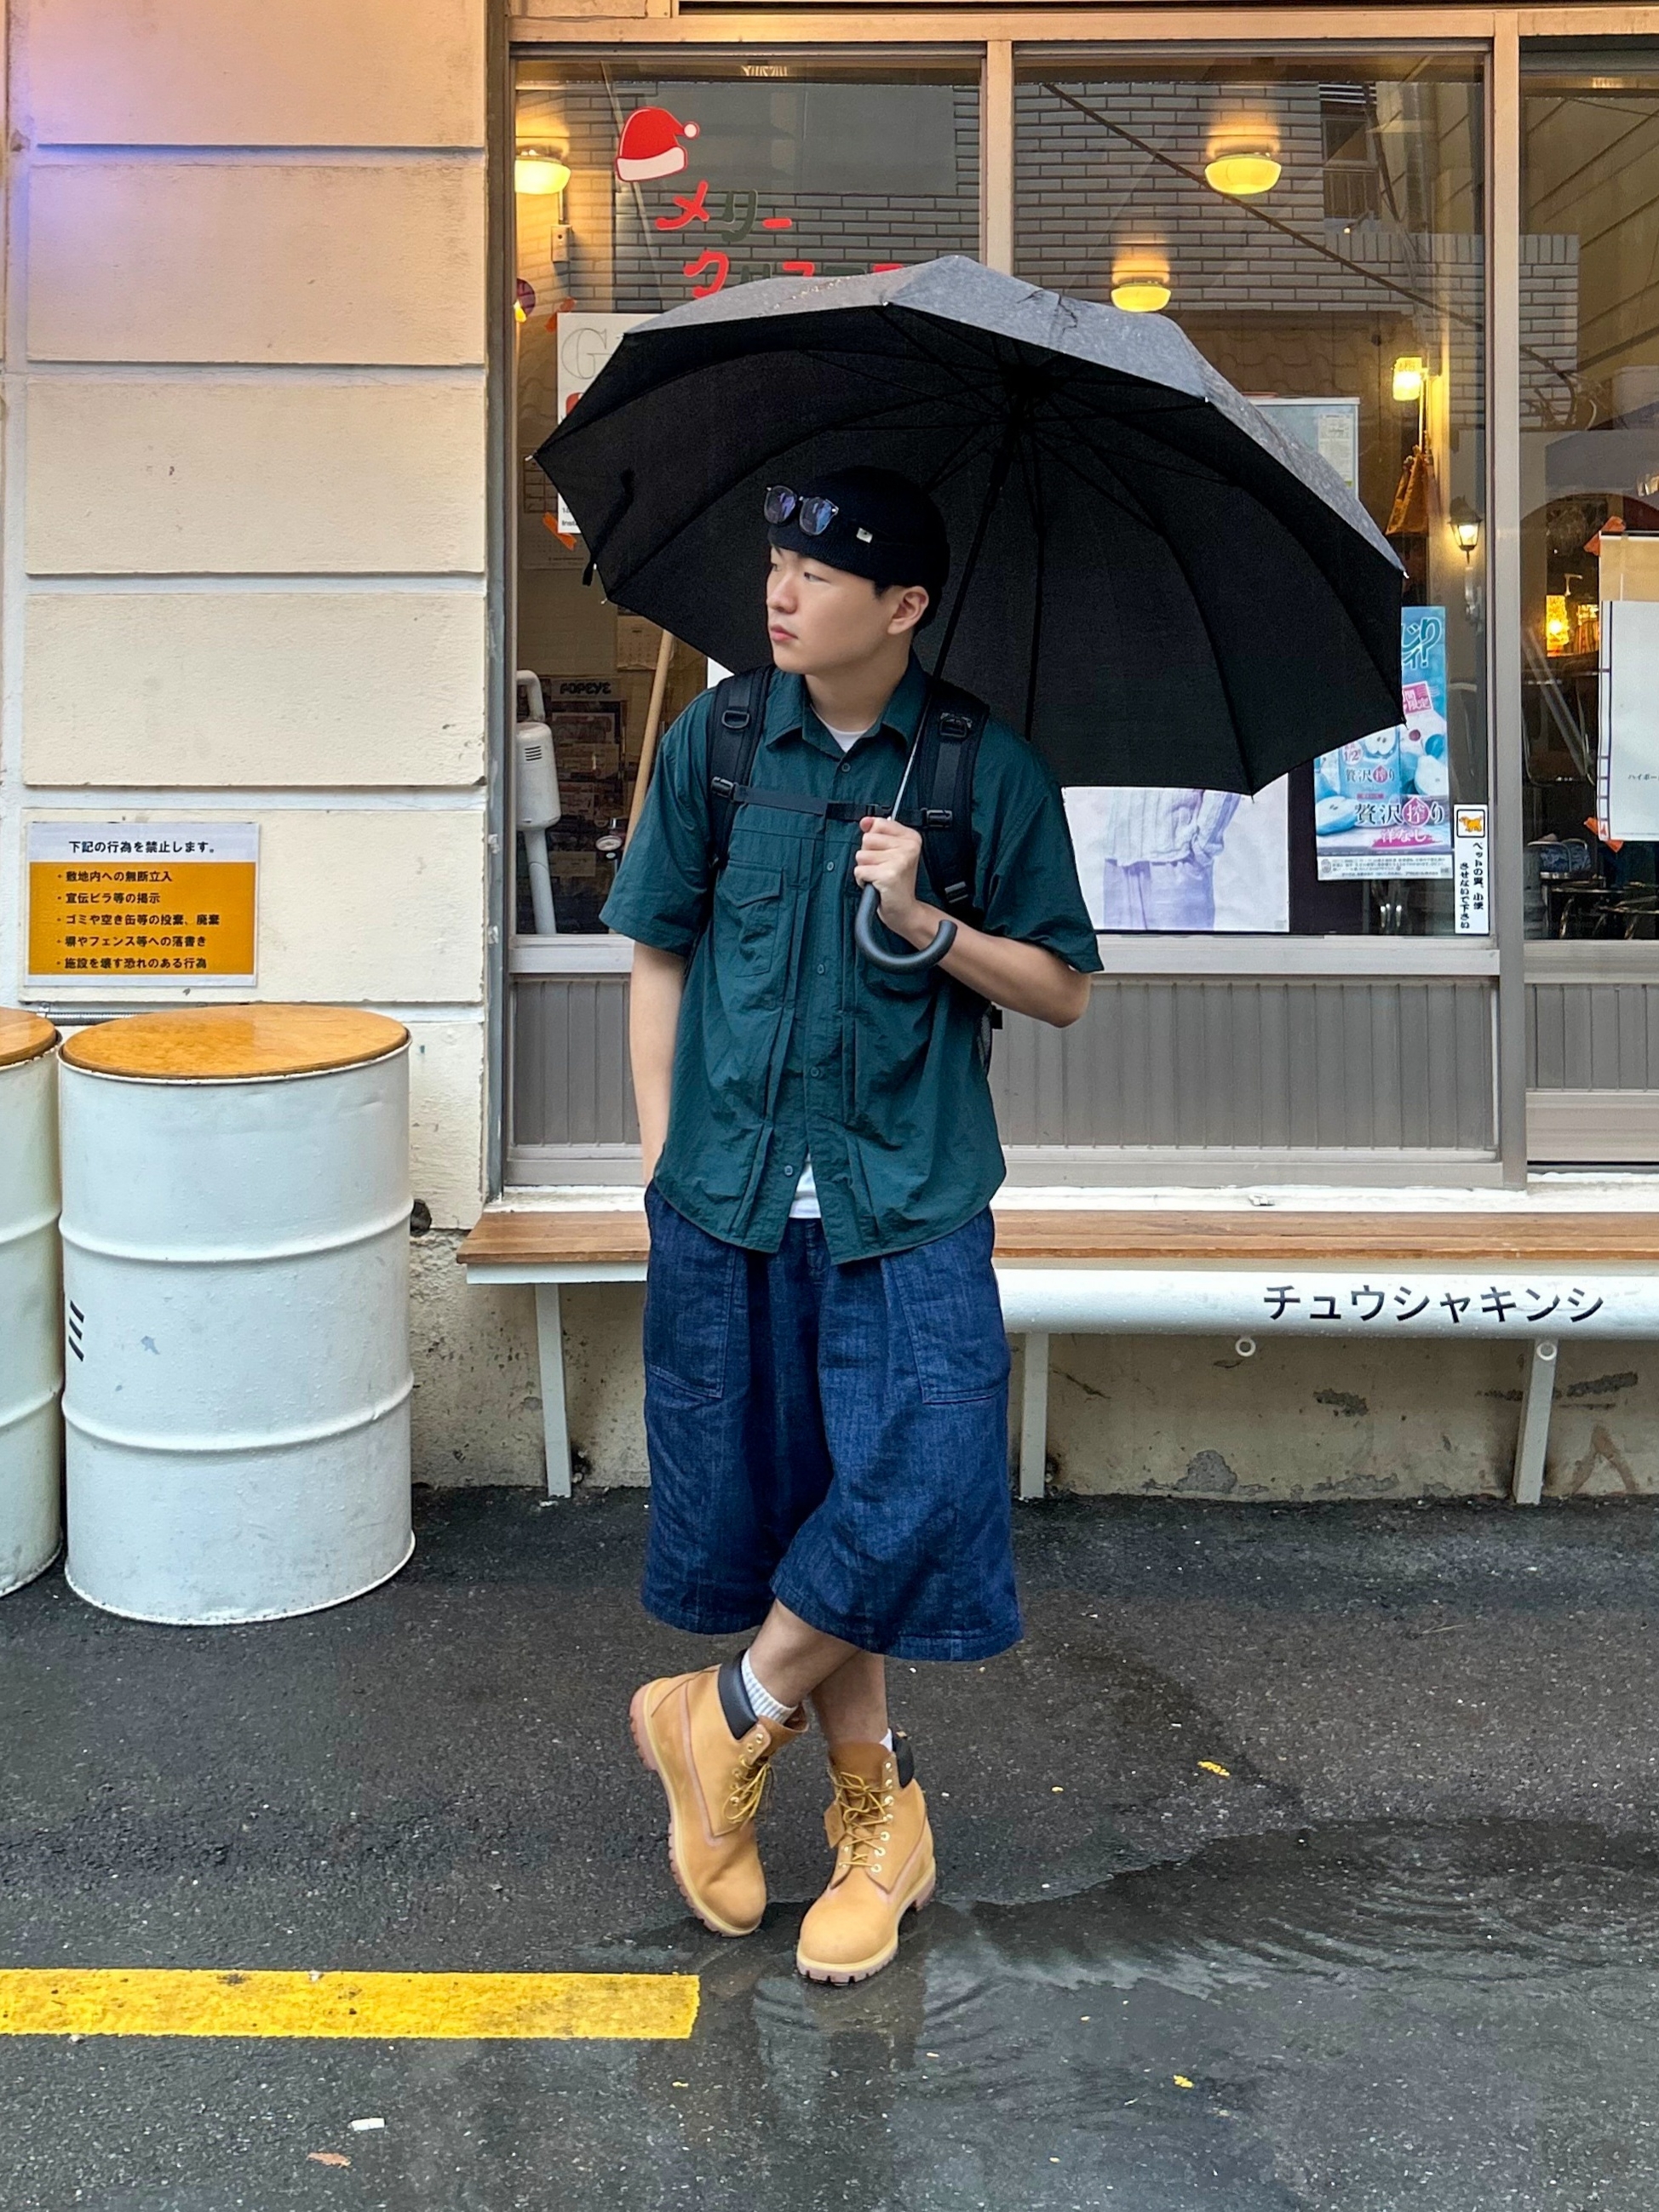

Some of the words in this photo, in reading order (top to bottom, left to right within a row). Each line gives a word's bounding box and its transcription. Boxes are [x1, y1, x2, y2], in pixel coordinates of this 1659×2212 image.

[655, 180, 792, 243] メリー
[1354, 799, 1444, 826] 贅沢搾り
[68, 840, 215, 854] 下記の行為を禁止します。
[1263, 1284, 1604, 1324] チュウシャキンシ
